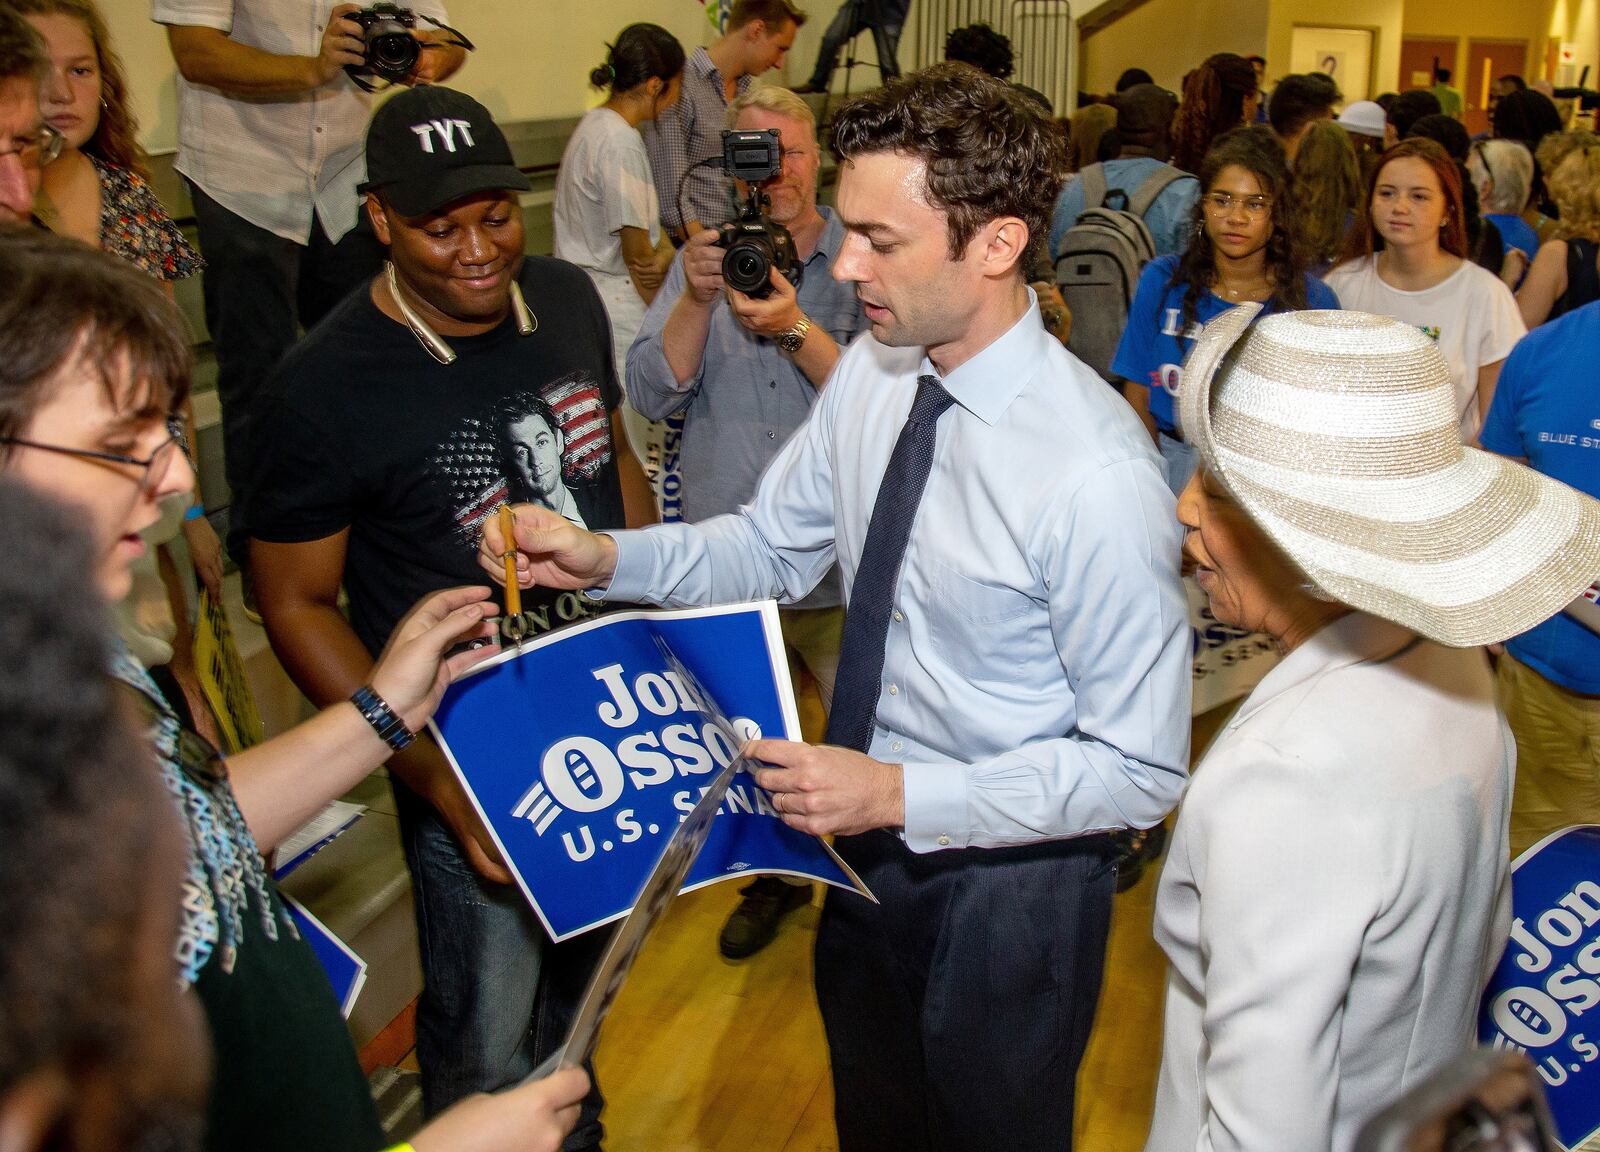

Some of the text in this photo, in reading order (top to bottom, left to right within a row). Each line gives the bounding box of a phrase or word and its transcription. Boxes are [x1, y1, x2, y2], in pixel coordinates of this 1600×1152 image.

[409, 118, 475, 153] TYT
[1538, 431, 1578, 446] BLUE
[543, 718, 762, 813] Osso
[562, 808, 660, 862] U.S.
